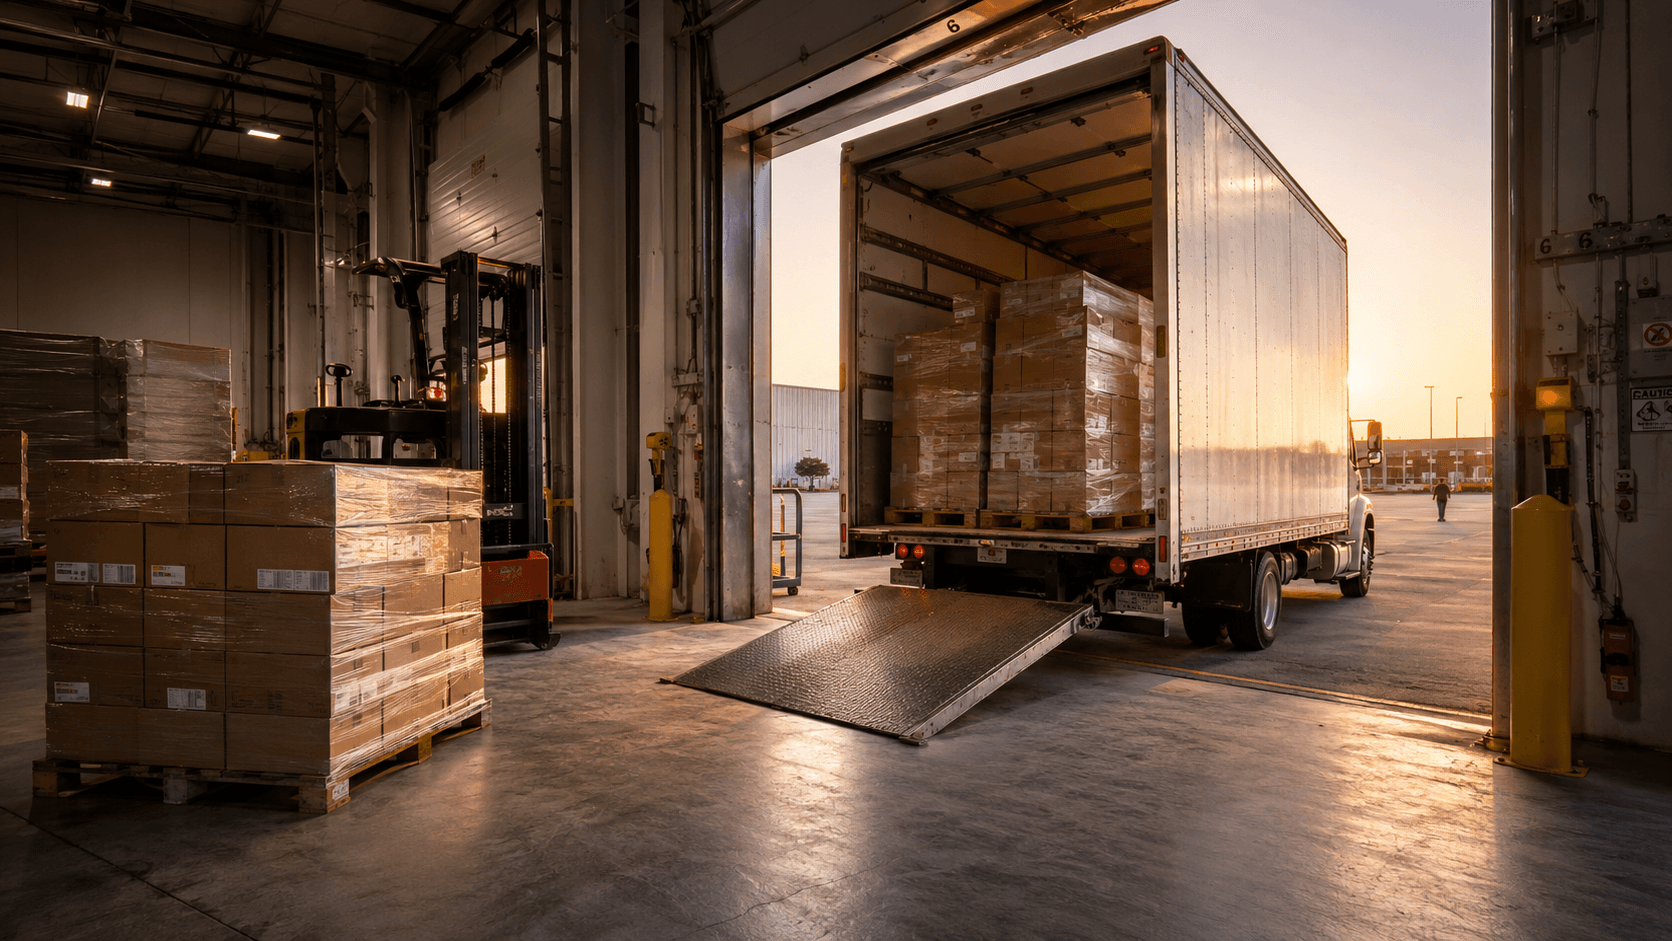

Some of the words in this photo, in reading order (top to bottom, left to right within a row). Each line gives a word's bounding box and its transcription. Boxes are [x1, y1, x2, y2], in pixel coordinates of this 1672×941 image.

[947, 19, 960, 33] 6
[1540, 238, 1552, 254] 6
[1578, 232, 1593, 249] 6
